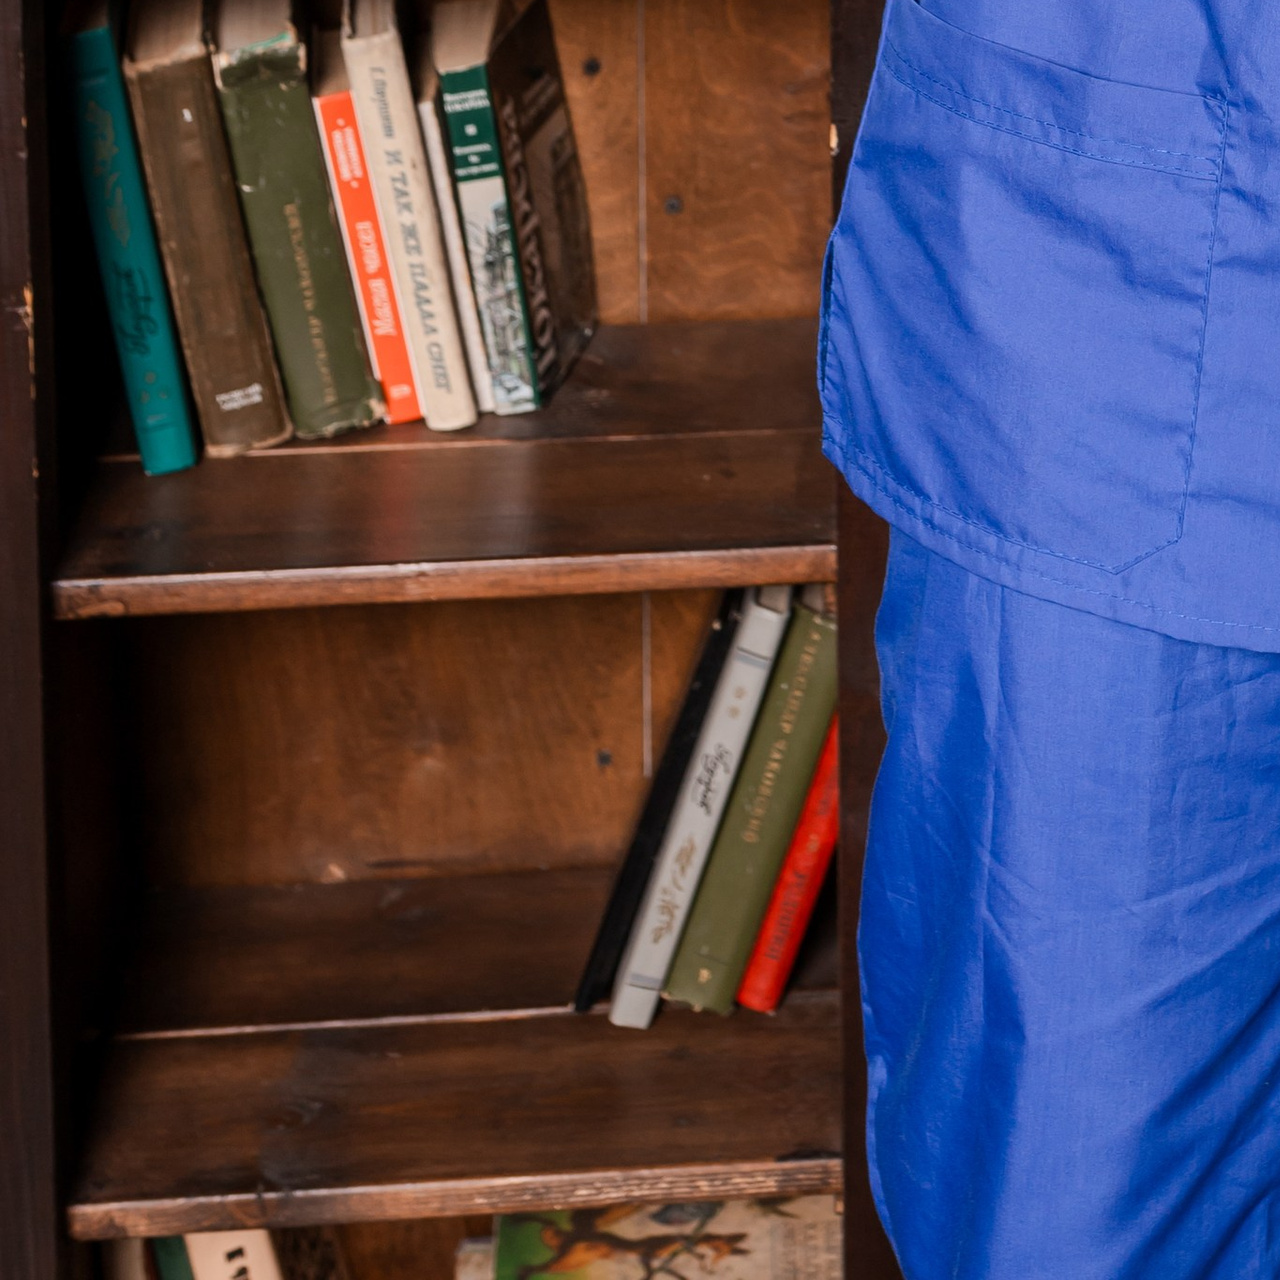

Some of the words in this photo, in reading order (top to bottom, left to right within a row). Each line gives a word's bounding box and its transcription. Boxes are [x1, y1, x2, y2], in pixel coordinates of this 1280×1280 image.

[389, 171, 414, 218] ТАК
[399, 221, 423, 257] ЖЕ
[406, 261, 440, 335] ПАДАЛ
[425, 341, 453, 396] СНЕГ
